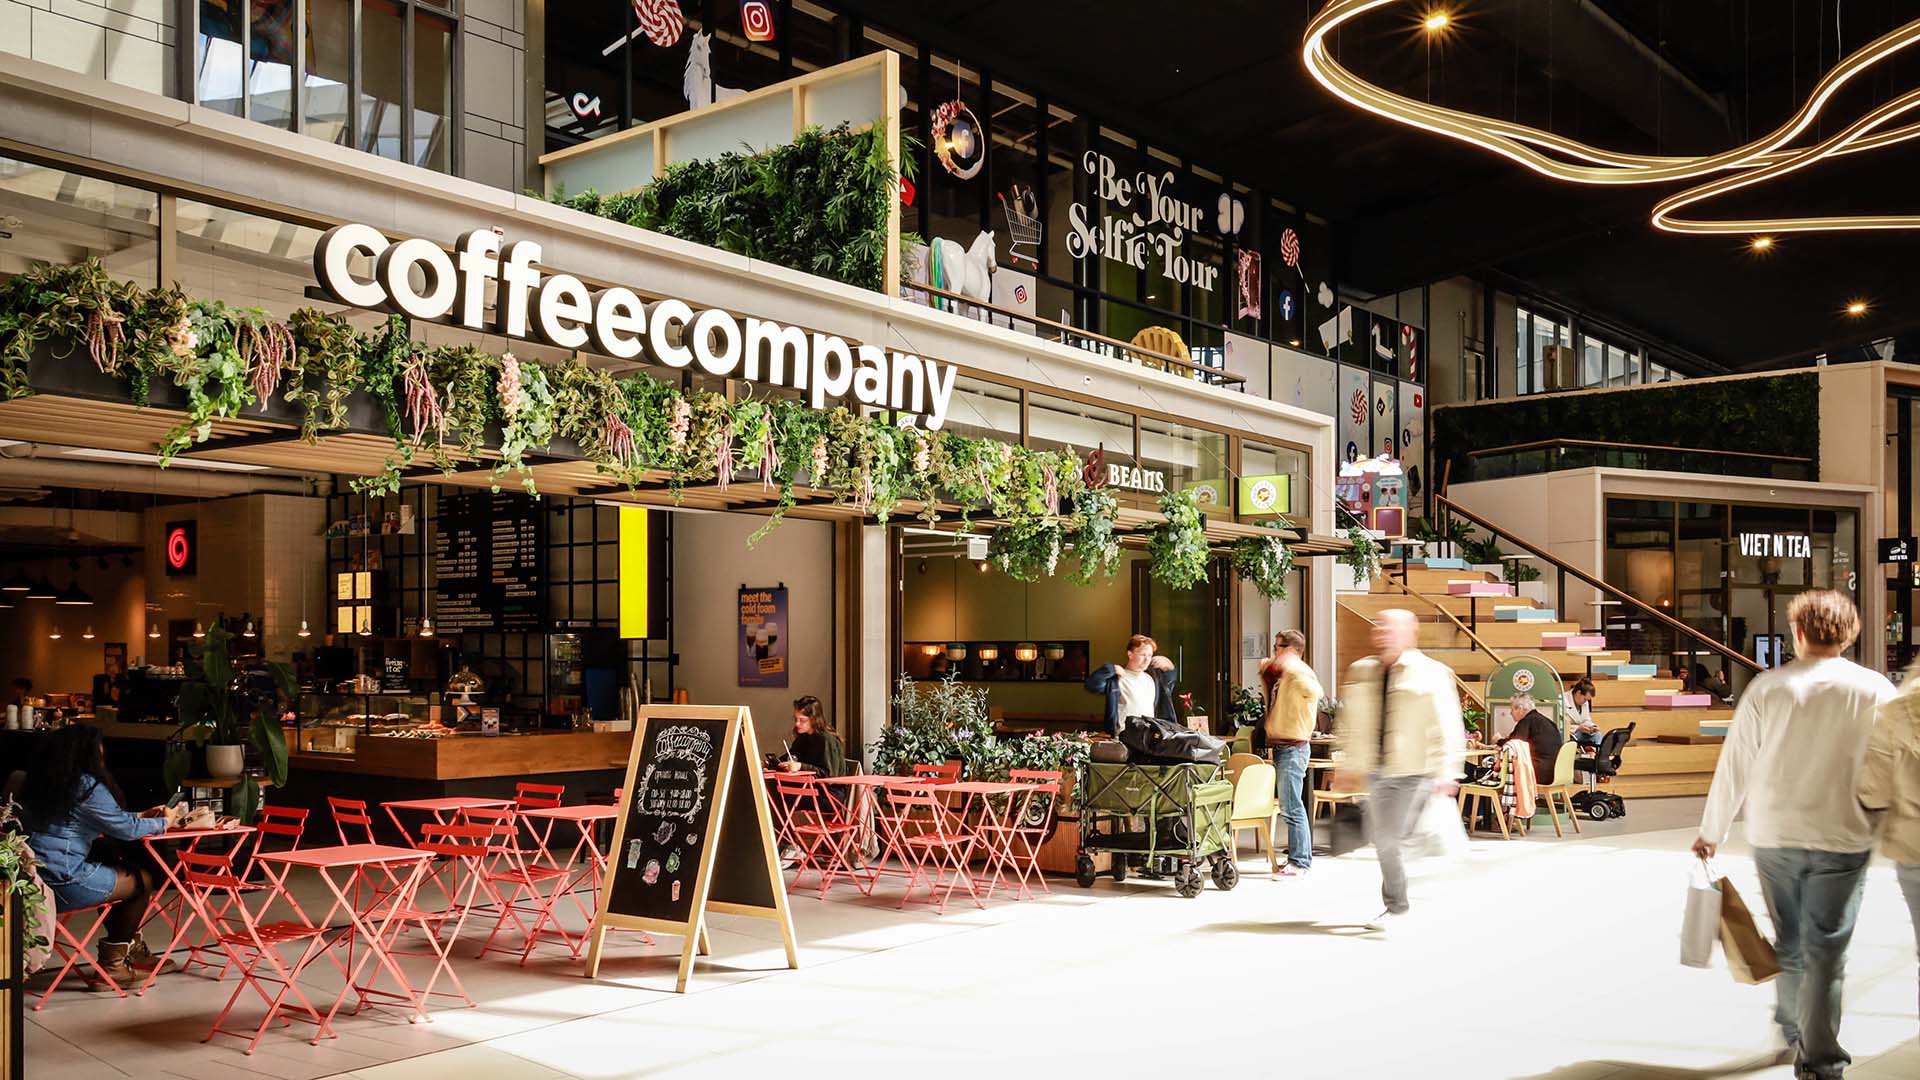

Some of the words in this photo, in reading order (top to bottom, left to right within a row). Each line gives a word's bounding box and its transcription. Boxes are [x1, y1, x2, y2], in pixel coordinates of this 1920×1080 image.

[1083, 150, 1132, 207] Be
[1133, 171, 1204, 233] Your
[1066, 202, 1155, 270] Selfie
[1155, 226, 1218, 292] Tour
[318, 223, 957, 431] coffeecompany
[1740, 533, 1771, 556] VIET
[1773, 534, 1784, 558] N
[1787, 535, 1811, 558] TEA
[742, 592, 758, 603] meet
[760, 591, 772, 602] the
